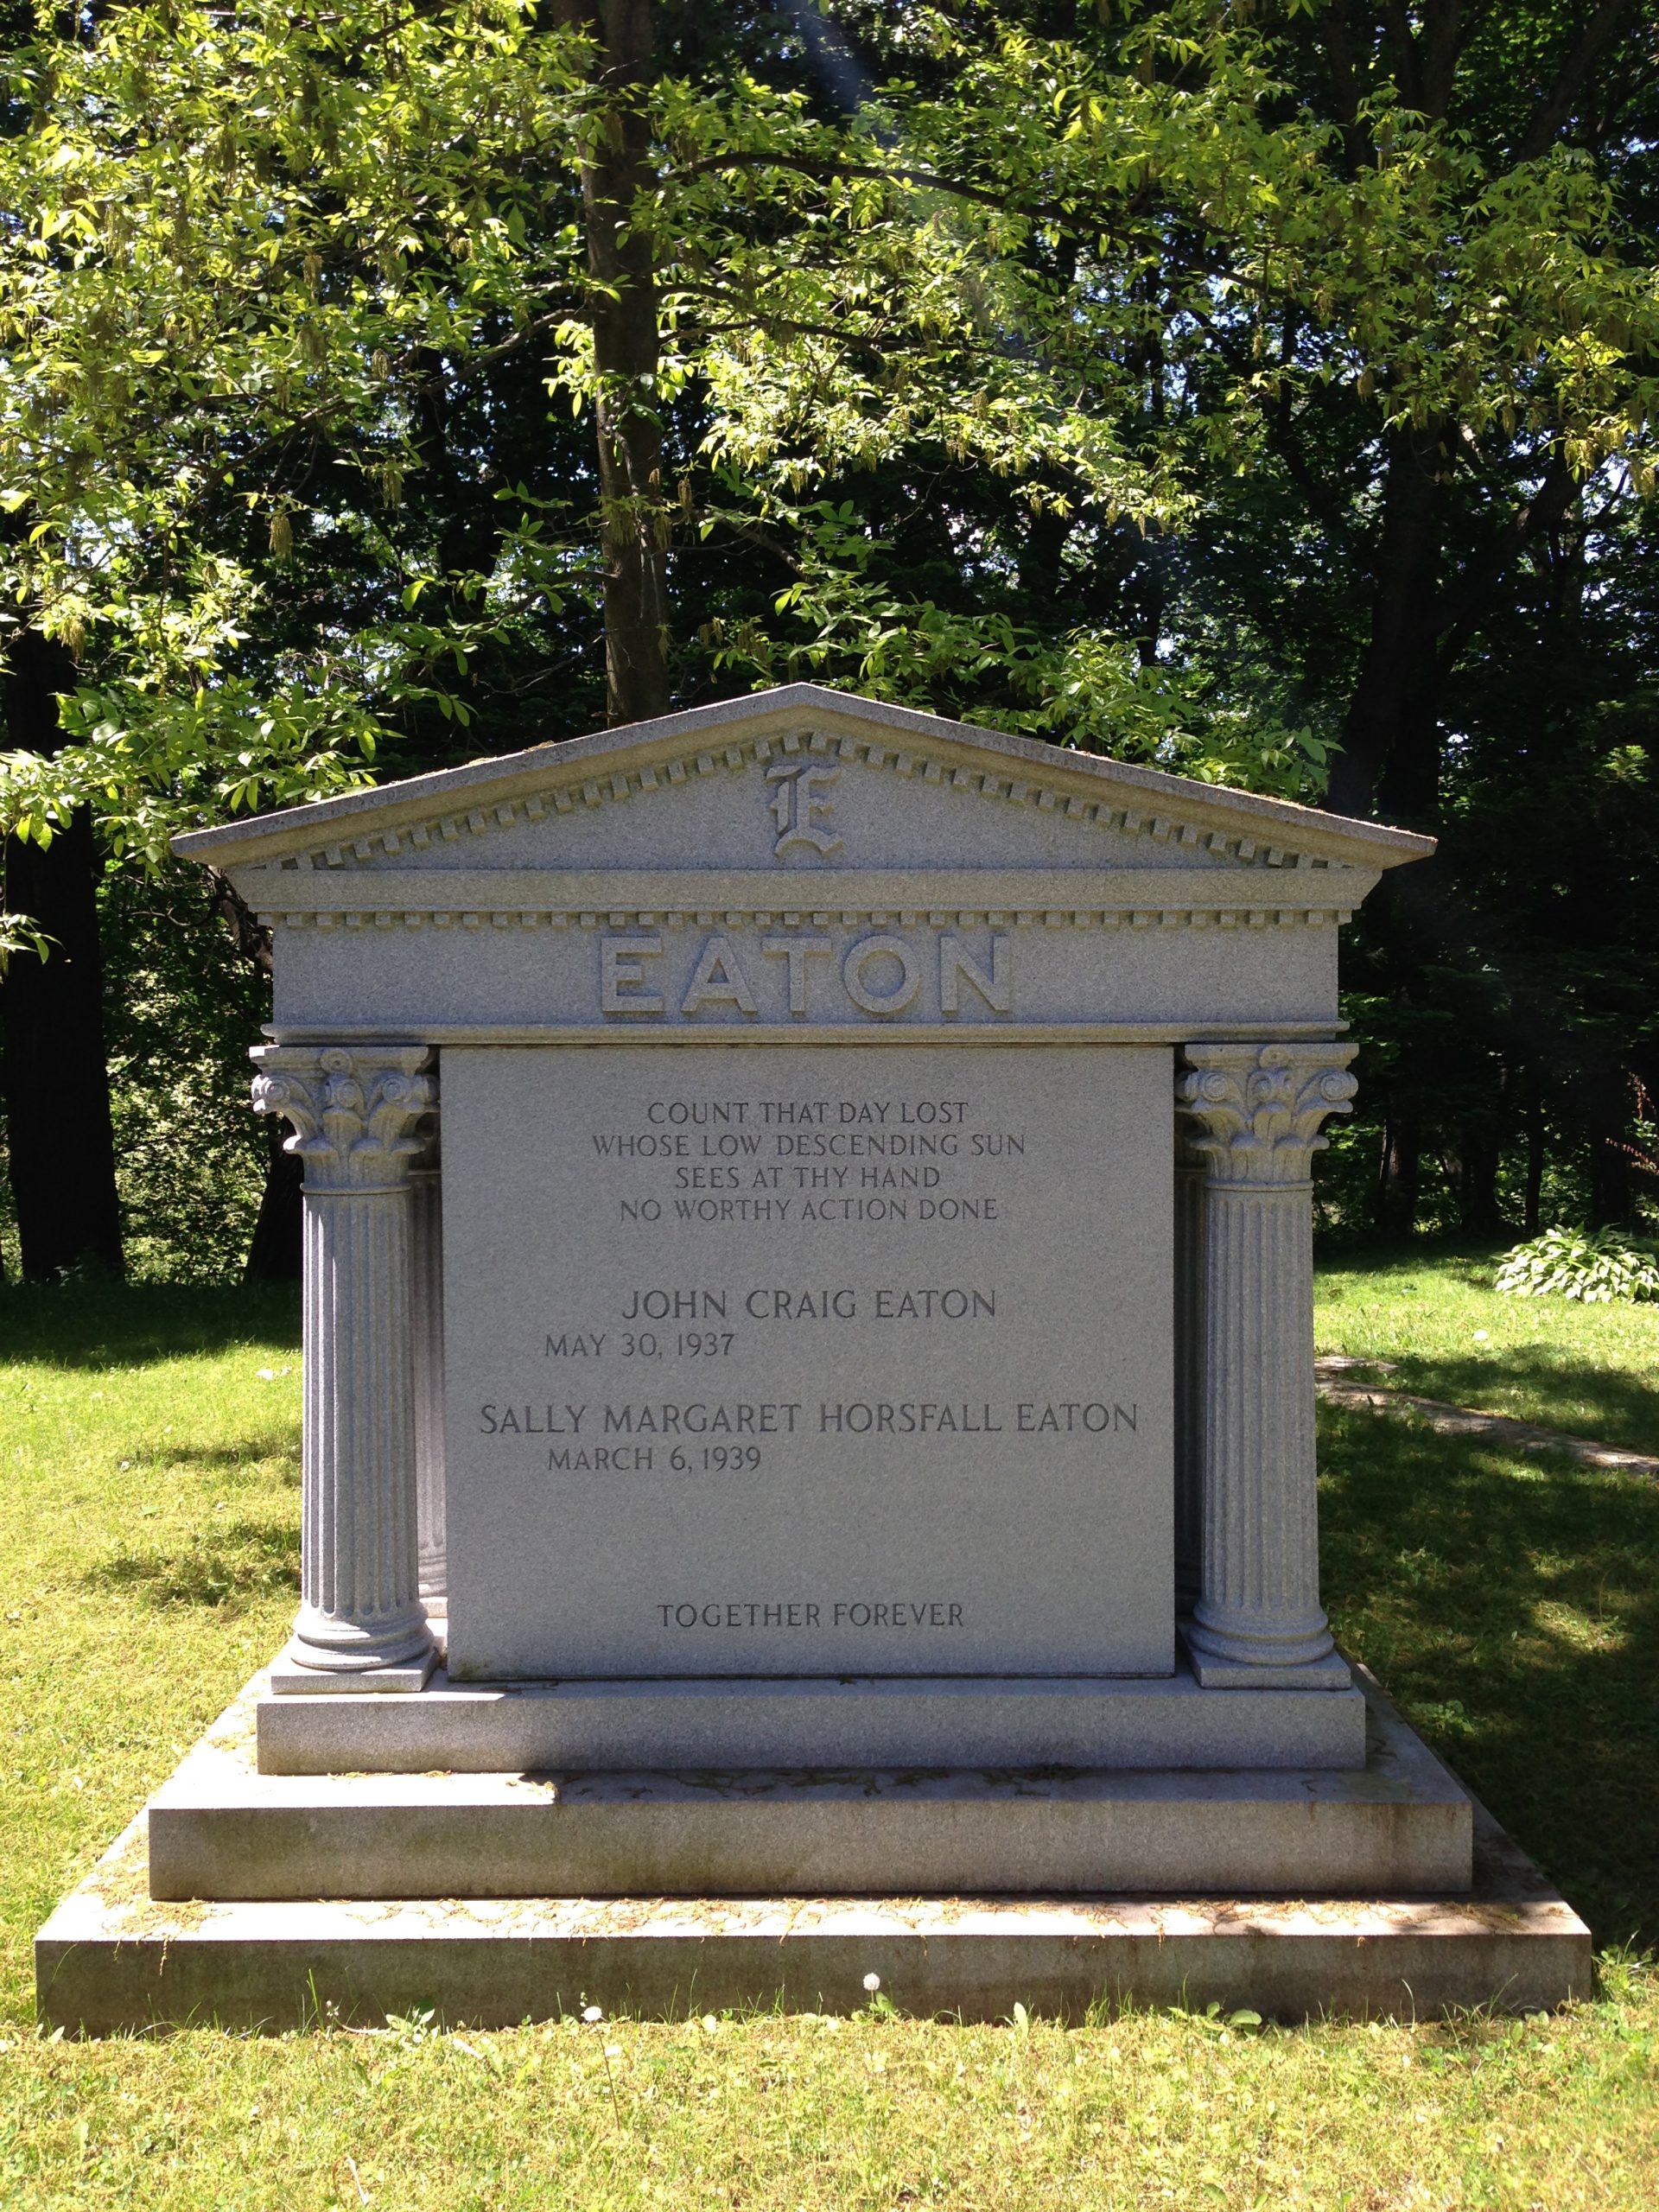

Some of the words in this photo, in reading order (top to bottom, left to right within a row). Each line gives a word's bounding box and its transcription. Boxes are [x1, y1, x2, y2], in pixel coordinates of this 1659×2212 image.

[765, 764, 844, 858] E
[601, 936, 1010, 1013] EATON
[646, 1101, 750, 1125] COUNT
[758, 1101, 830, 1124] THAT
[838, 1101, 891, 1124] DAY
[900, 1100, 969, 1124] LOST
[592, 1134, 690, 1158] WHOSE
[702, 1134, 762, 1157] LOW
[776, 1133, 958, 1157] DESCENDING
[970, 1133, 1025, 1157] SUN
[674, 1166, 741, 1190] SEES
[751, 1166, 784, 1189] AT
[792, 1166, 849, 1189] THY
[861, 1166, 941, 1189] HAND
[620, 1198, 662, 1222] NO
[673, 1198, 791, 1223] WORTHY
[801, 1198, 907, 1222] ACTION
[918, 1198, 999, 1221] DONE
[620, 1289, 727, 1320] JOHN
[744, 1288, 856, 1320] CRAIG
[874, 1288, 996, 1319] EATON
[544, 1333, 607, 1357] MAY
[620, 1332, 664, 1360] 30,
[677, 1332, 735, 1358] 1937
[479, 1403, 588, 1435] SALLY
[603, 1402, 803, 1435] MARGARET
[819, 1402, 1003, 1434] HORSFALL
[1016, 1402, 1138, 1433] EATON
[547, 1446, 653, 1471] MARCH
[669, 1445, 693, 1474] 6,
[702, 1445, 762, 1472] 1939
[656, 1602, 821, 1629] TOGETHER
[833, 1602, 964, 1628] FOREVER
